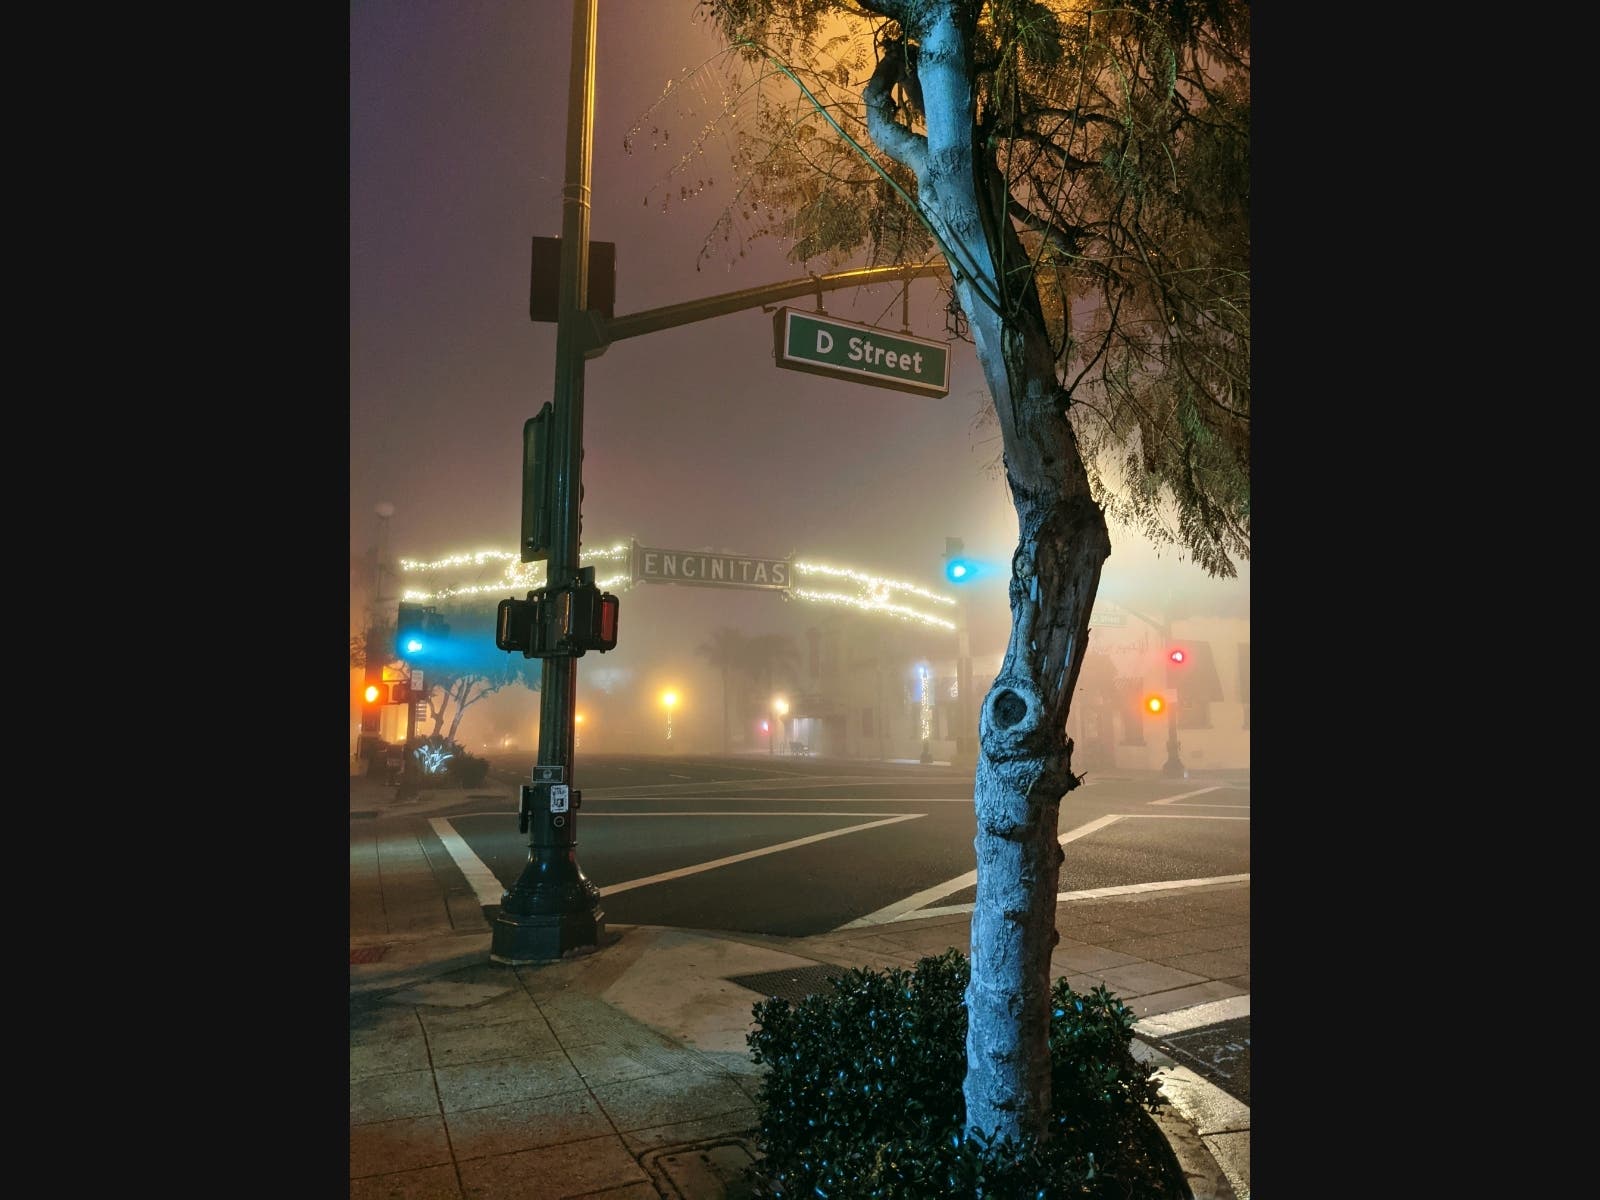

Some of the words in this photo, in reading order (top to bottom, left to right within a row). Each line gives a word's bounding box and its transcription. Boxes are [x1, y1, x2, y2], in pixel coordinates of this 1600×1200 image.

[816, 330, 833, 354] D
[848, 337, 922, 373] Street
[644, 553, 785, 584] ENCINITAS
